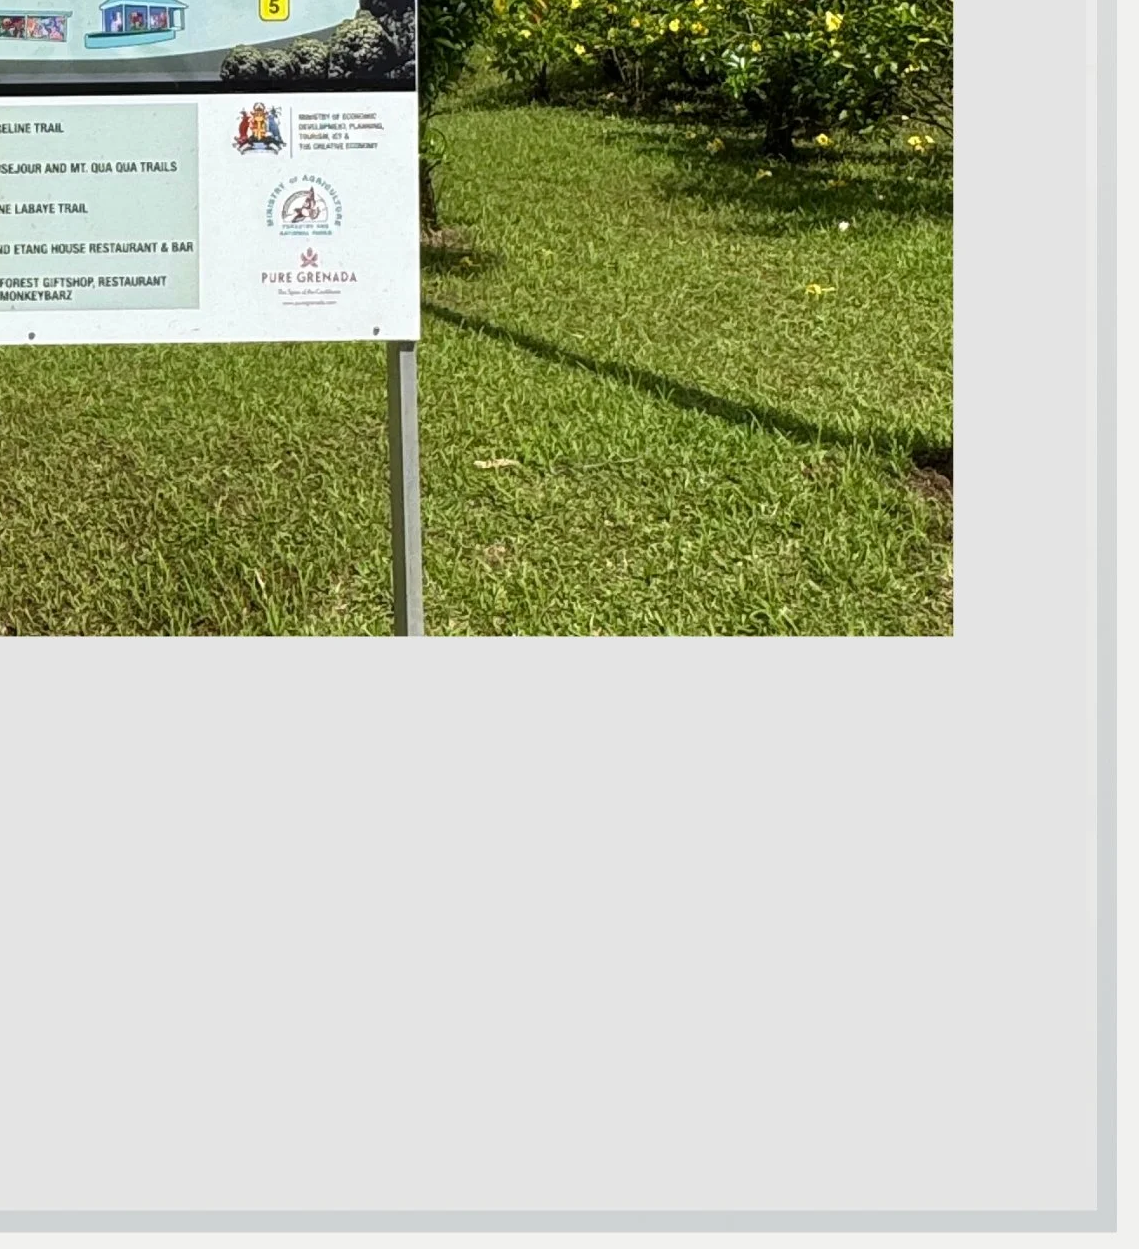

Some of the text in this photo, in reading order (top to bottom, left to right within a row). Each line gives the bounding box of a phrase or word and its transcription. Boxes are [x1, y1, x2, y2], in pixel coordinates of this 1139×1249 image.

[34, 122, 64, 134] TRAIL
[44, 163, 67, 174] AND
[70, 162, 88, 174] MT.
[91, 162, 112, 174] QUA
[115, 162, 137, 174] QUA
[140, 161, 177, 173] TRAILS
[15, 203, 55, 214] LABAYE
[58, 203, 88, 214] TRAIL
[13, 243, 47, 255] ETANG
[51, 243, 85, 254] HOUSE
[89, 242, 158, 254] RESTAURANT
[161, 242, 169, 253] &
[171, 242, 194, 253] BAR
[42, 276, 95, 289] GIFTSHOP,
[98, 276, 167, 287] RESTAURANT
[261, 271, 358, 283] PURE GRENADA
[0, 289, 73, 301] MONKEYBARZ
